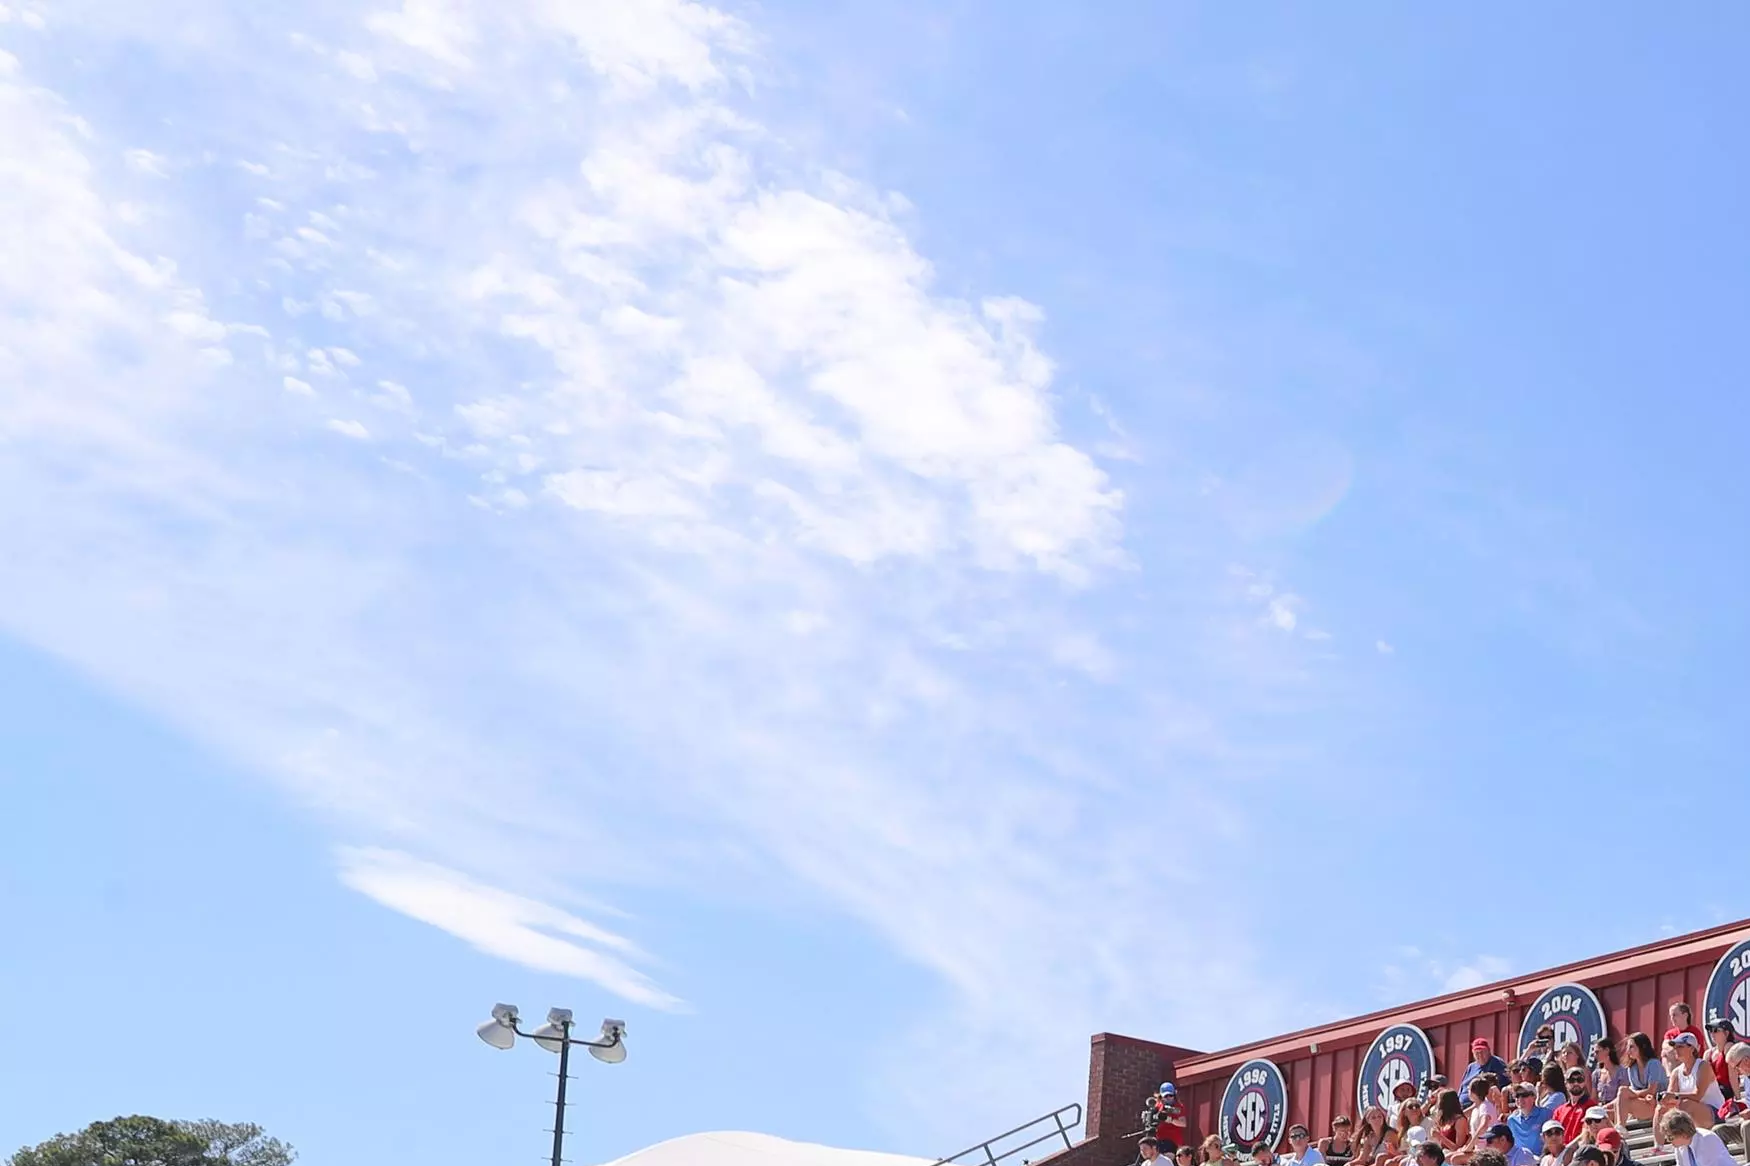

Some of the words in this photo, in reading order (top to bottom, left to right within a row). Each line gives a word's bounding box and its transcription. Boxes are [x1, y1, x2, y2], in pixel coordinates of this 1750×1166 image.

[1541, 994, 1582, 1020] 2004
[1379, 1034, 1412, 1059] 1997
[1238, 1069, 1267, 1091] 1996
[1236, 1092, 1266, 1141] SEC
